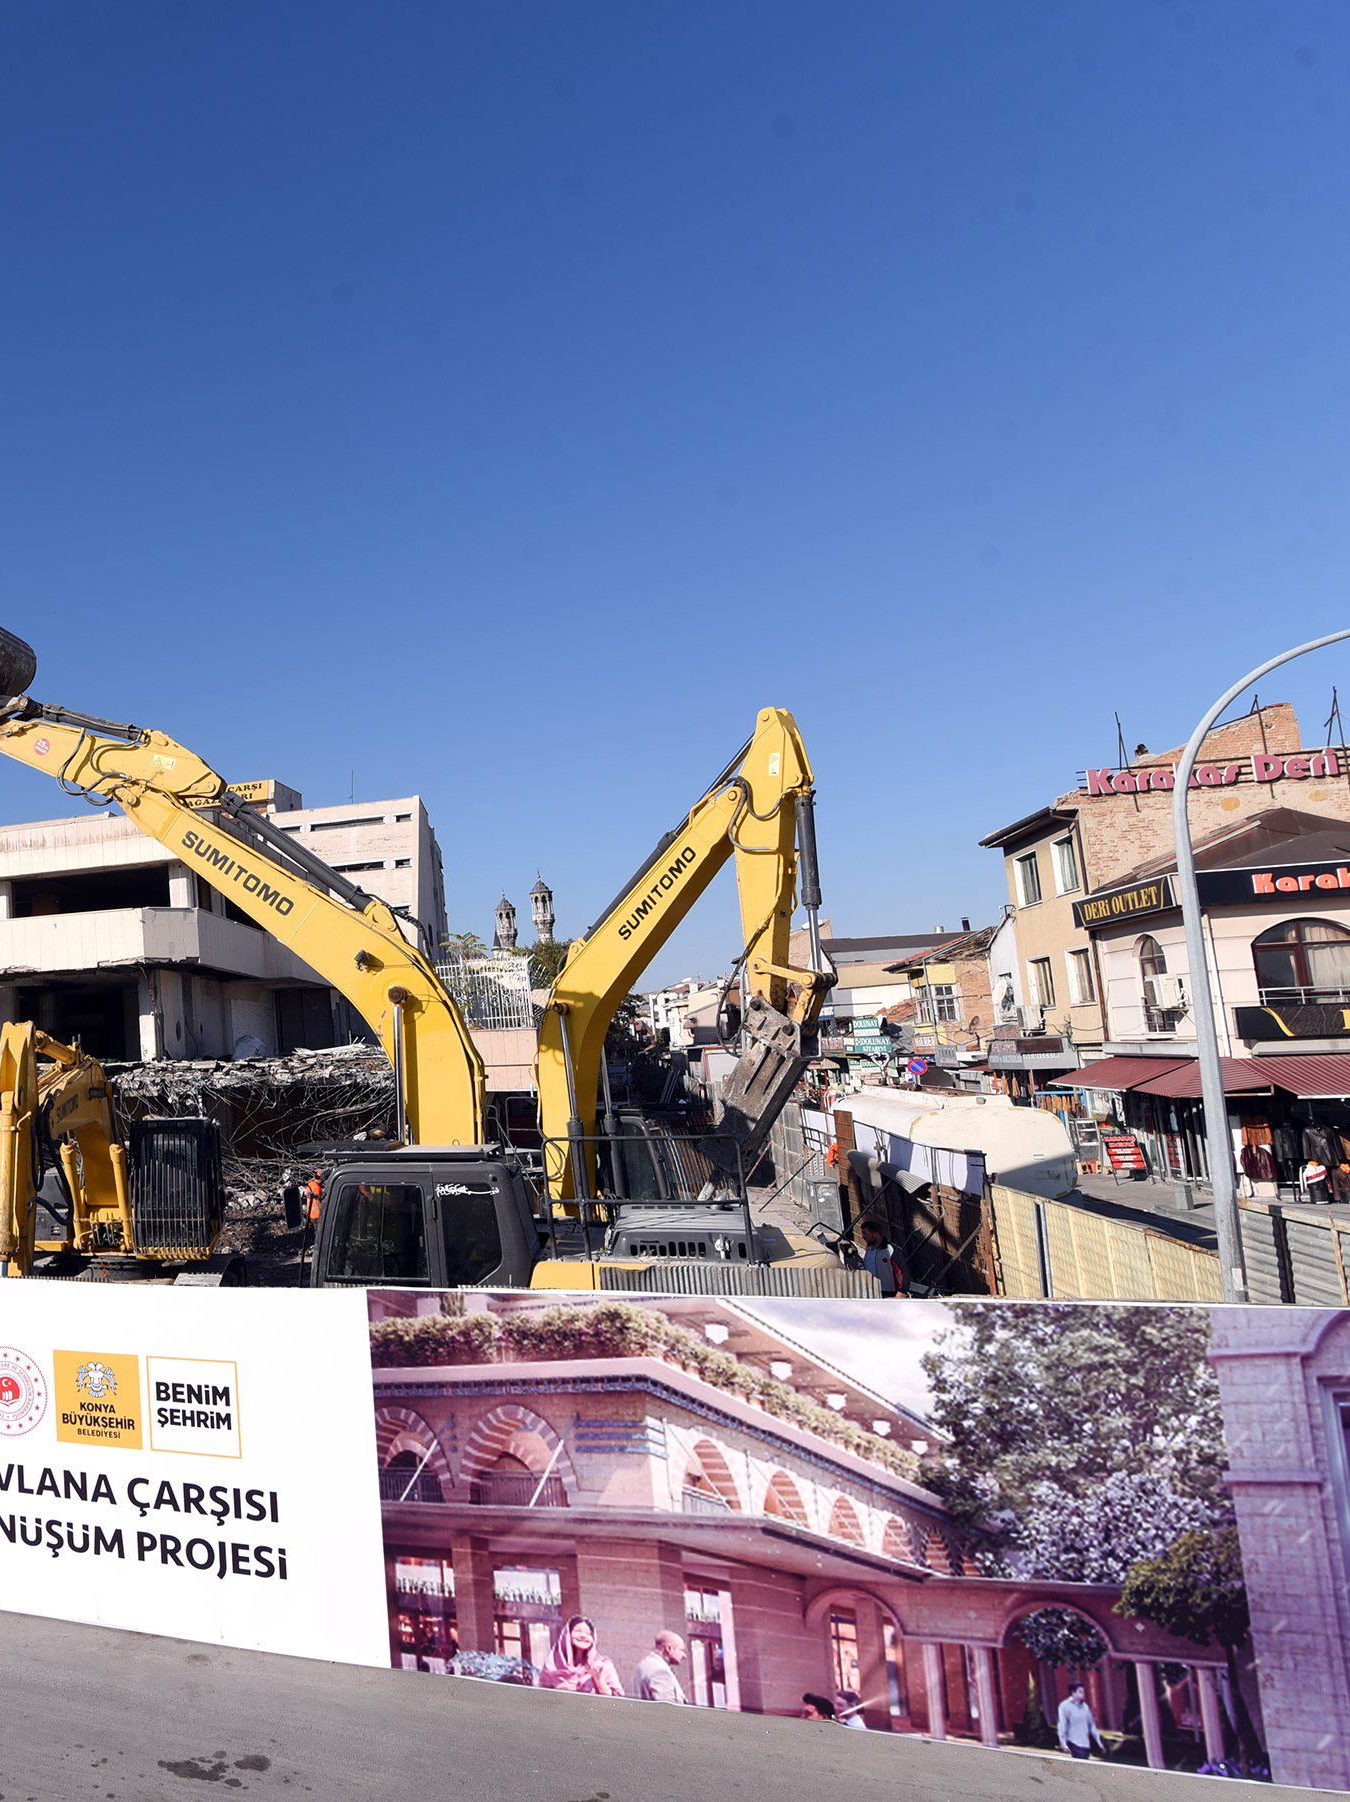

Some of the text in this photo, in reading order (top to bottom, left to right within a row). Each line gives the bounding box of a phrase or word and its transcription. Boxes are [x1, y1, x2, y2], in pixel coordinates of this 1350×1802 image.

[1251, 748, 1339, 782] Deri
[181, 830, 294, 916] SUMITOMO
[618, 846, 696, 940] SUMITOMO
[1111, 886, 1158, 914] OUTLET
[854, 1020, 878, 1028] DOLUNAY
[862, 1037, 890, 1046] DOLUNAY
[62, 1411, 135, 1430] BÜYÜKŞEHİR
[79, 1402, 116, 1414] KONYA
[77, 1428, 121, 1439] BELEDİYESİ
[127, 1477, 279, 1527] ÇARŞISI
[137, 1532, 288, 1580] PROJESİ
